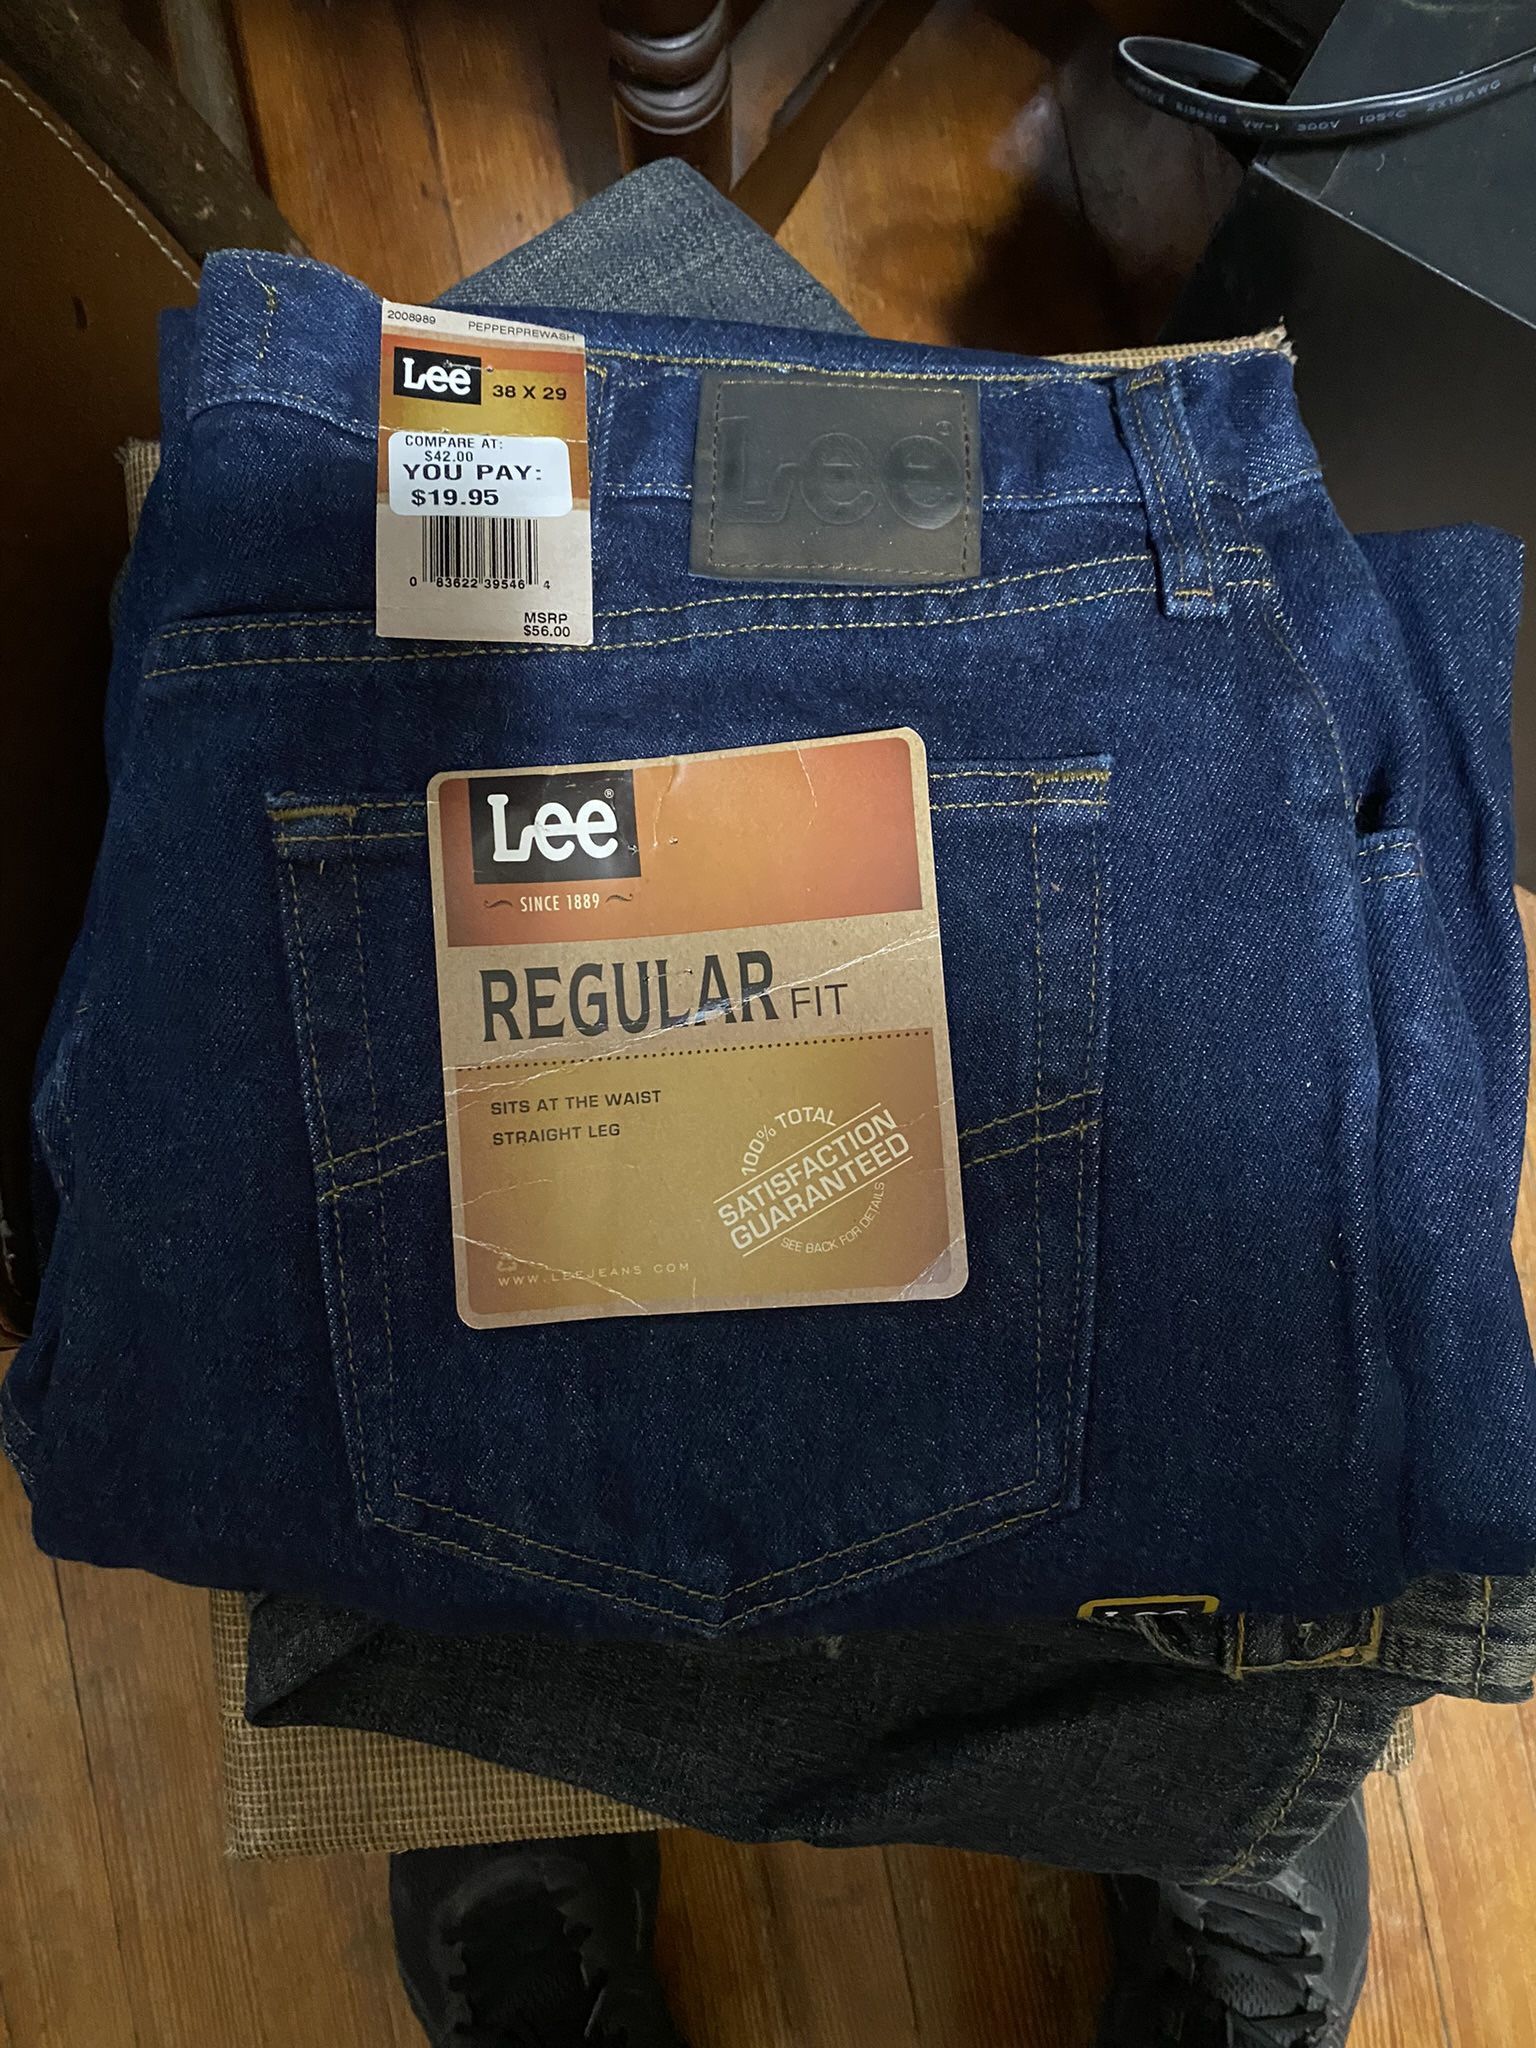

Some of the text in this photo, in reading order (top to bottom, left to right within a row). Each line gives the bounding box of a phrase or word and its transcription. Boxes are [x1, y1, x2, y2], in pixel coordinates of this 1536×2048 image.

[1296, 119, 1341, 132] 300V
[387, 309, 436, 325] 2008989
[468, 321, 576, 342] PEPPERPREWASH
[402, 357, 471, 395] Lee
[492, 385, 516, 398] 38
[542, 388, 567, 400] 29
[405, 435, 503, 449] COMPARE AT:
[424, 450, 474, 462] $42.00
[403, 464, 542, 481] YOU PAY:
[411, 489, 499, 507] $19.95
[409, 577, 418, 587] 0
[436, 577, 478, 589] 83622
[484, 579, 526, 590] 39546
[524, 612, 568, 624] MSRP
[523, 625, 571, 638] $56.00
[486, 793, 618, 863] Lee
[519, 893, 600, 912] SINCE 1889
[479, 950, 849, 1043] REGULAR FIT
[490, 1090, 662, 1116] SITS AT THE WAIST
[492, 1123, 621, 1146] STRAIGHT LEG
[741, 1106, 837, 1176] 100% TOTAL
[717, 1108, 897, 1227] SATISFACTION
[729, 1132, 910, 1250] GUARANTEED
[780, 1181, 886, 1254] SEE BACK FOR DETAILS
[497, 1262, 690, 1287] WWW.LEEJEANSCOM
